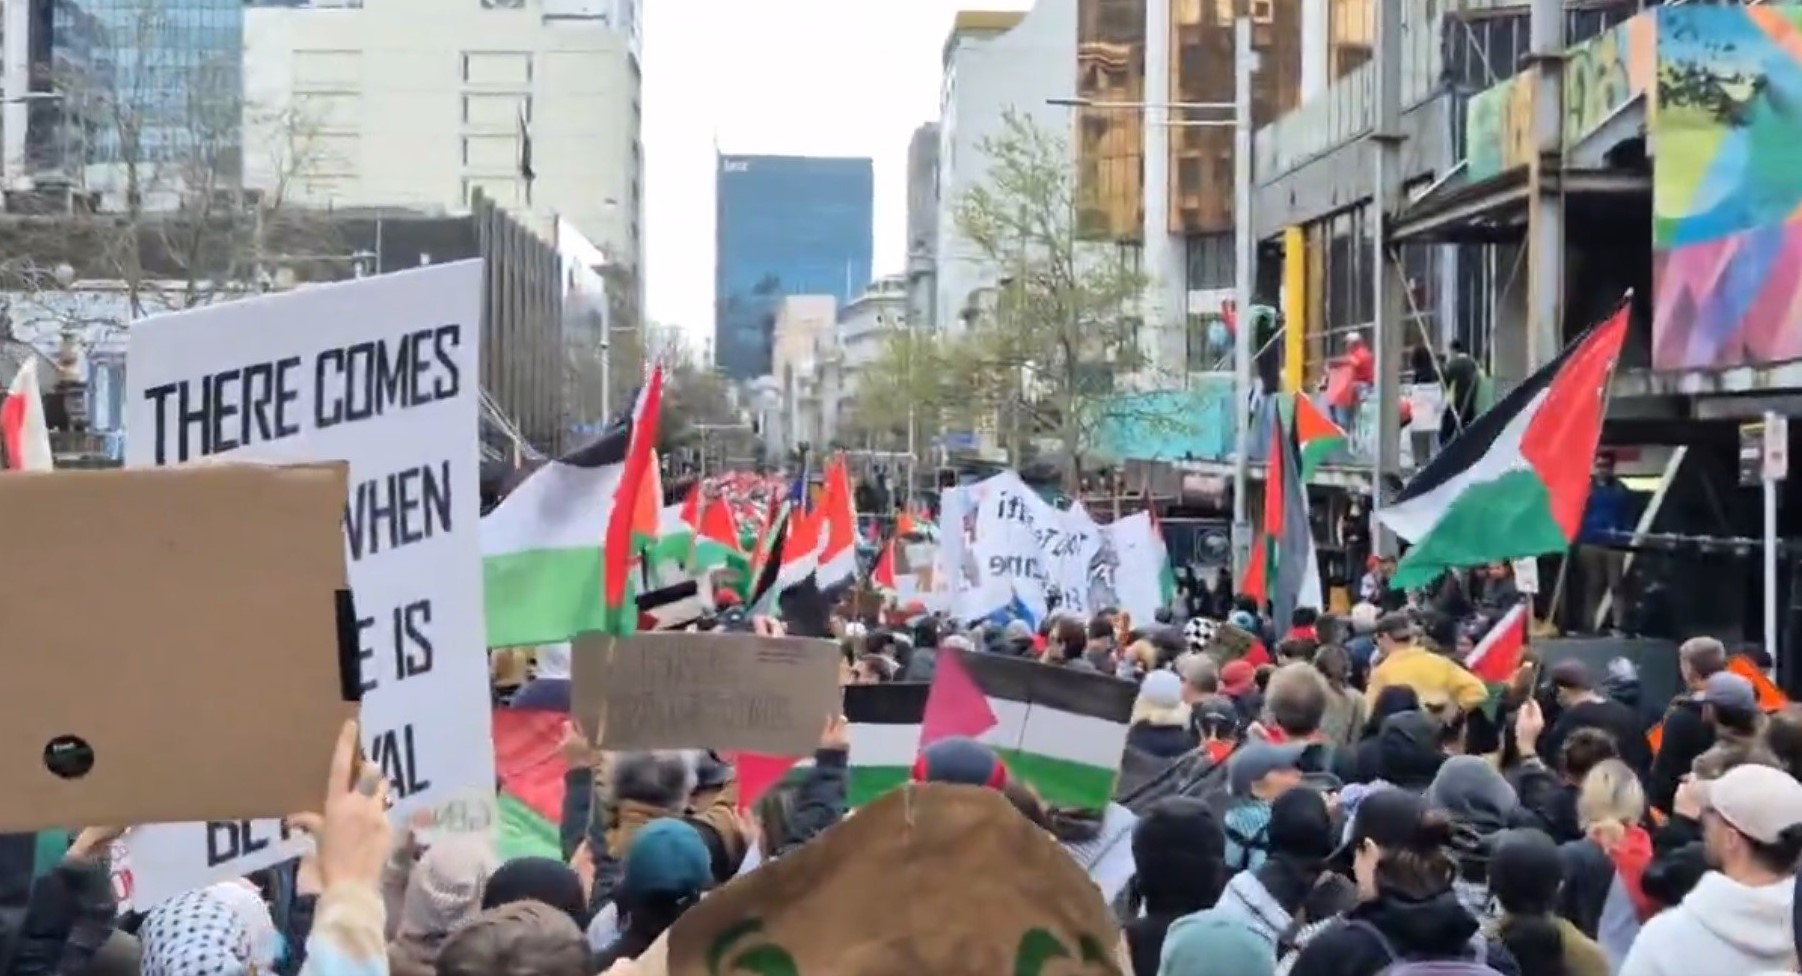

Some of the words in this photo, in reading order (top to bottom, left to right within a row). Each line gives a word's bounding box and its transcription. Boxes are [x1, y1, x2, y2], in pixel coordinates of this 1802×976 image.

[144, 356, 301, 466] THERE
[314, 324, 460, 429] COMES
[393, 599, 433, 680] IS
